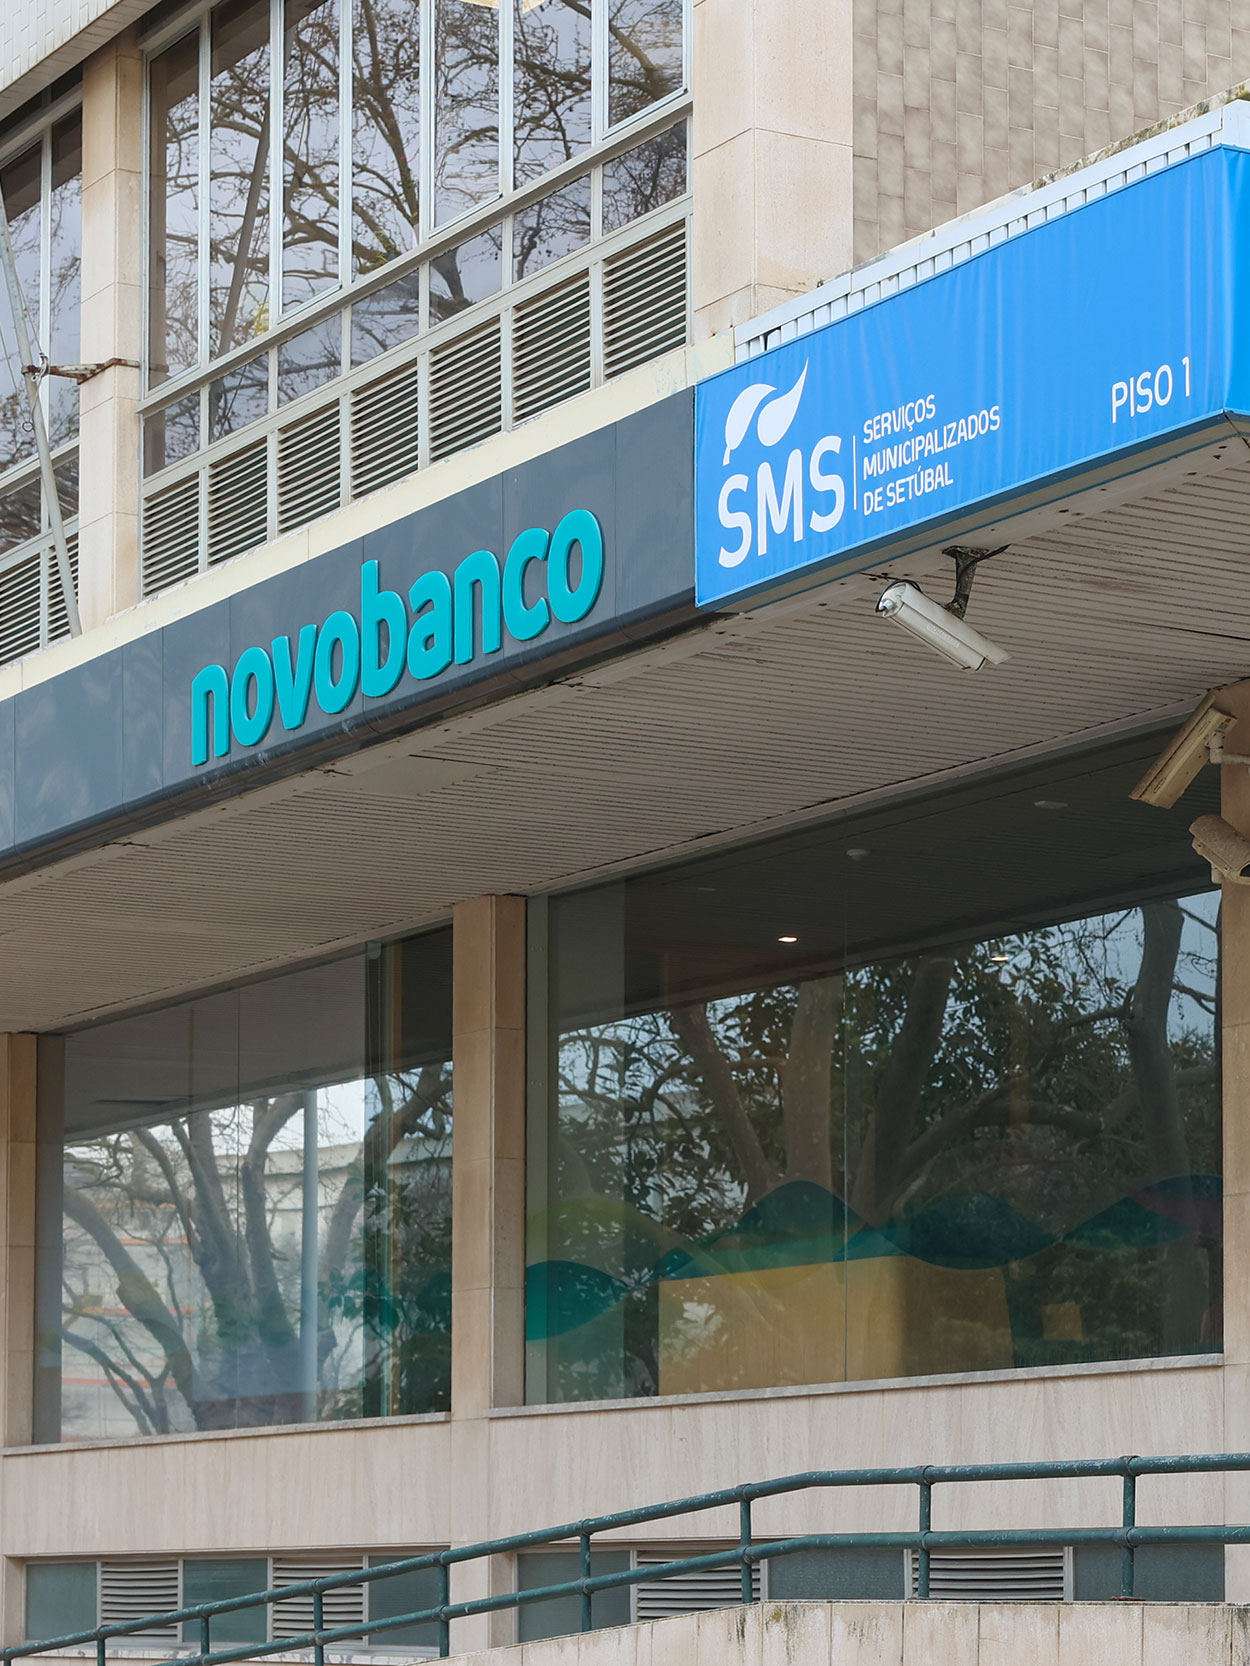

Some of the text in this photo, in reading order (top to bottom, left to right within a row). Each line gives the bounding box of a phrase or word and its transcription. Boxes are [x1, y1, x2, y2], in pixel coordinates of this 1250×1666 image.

[863, 394, 936, 445] SERVIÇOS
[1111, 356, 1190, 424] PISO 1
[863, 405, 1001, 480] MUNICIPALIZADOS
[718, 435, 845, 568] SMS
[863, 461, 954, 516] DE SETÚBAL
[191, 508, 603, 767] novobanco
